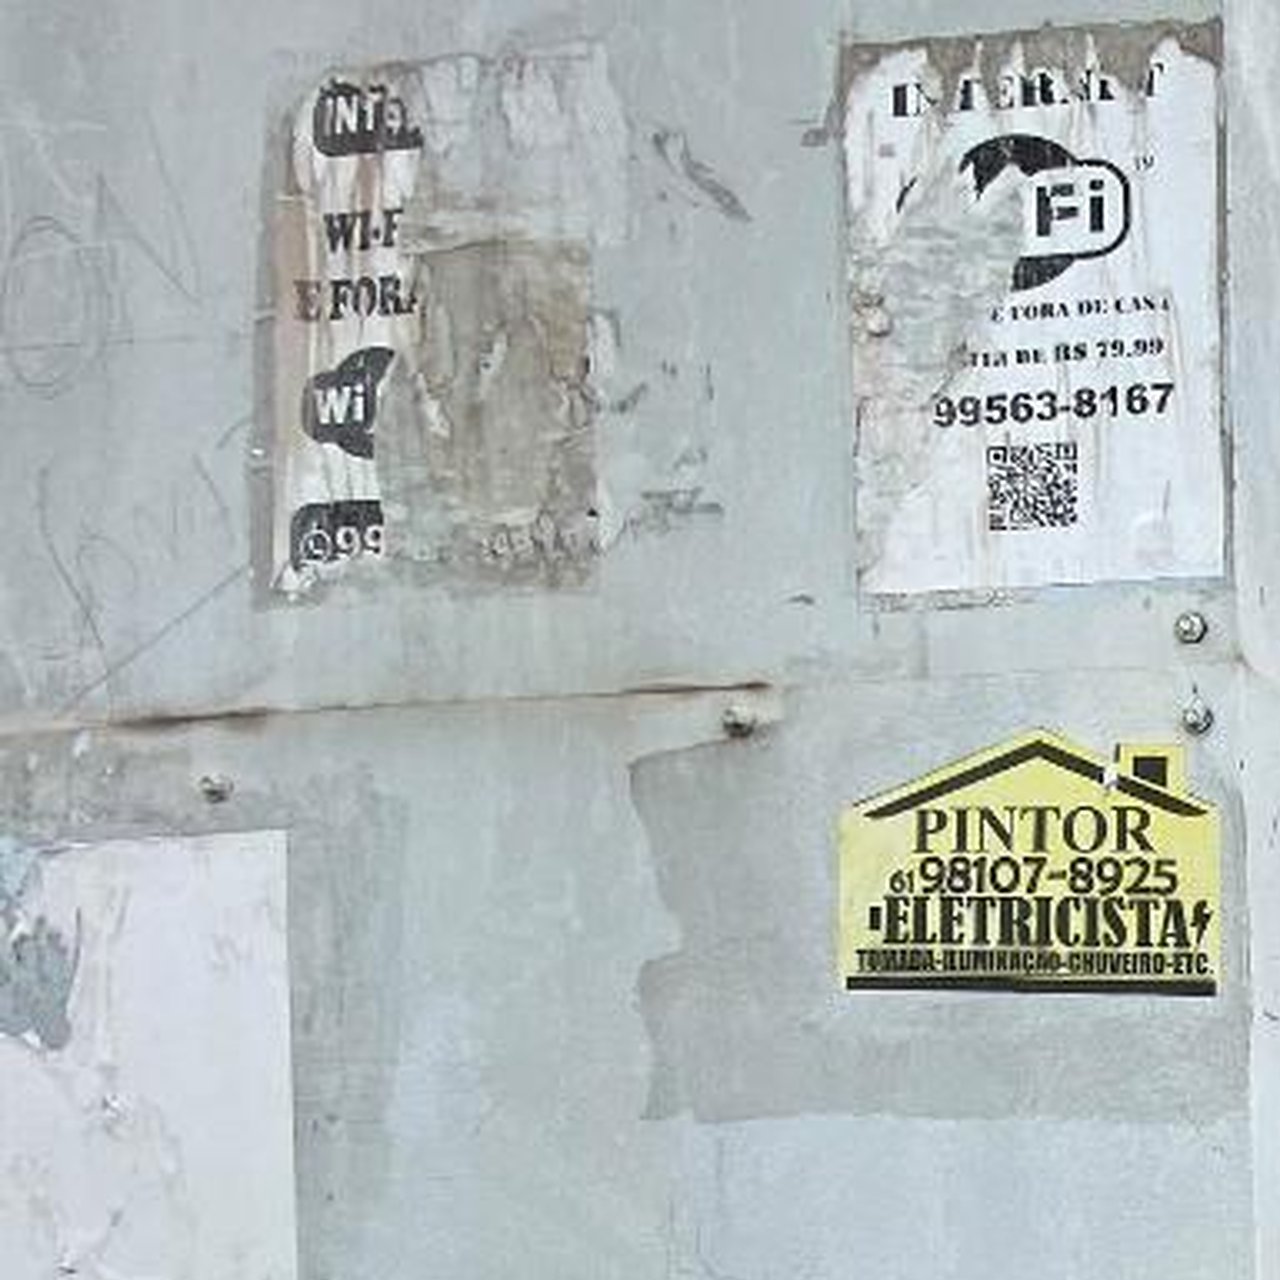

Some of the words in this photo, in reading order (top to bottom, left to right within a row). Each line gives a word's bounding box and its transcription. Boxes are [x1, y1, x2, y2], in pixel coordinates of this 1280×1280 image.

[1078, 299, 1108, 315] DE
[933, 383, 1175, 428] 99563-8167
[911, 804, 1157, 855] PINTOR
[882, 895, 1191, 948] ELETRICISTA
